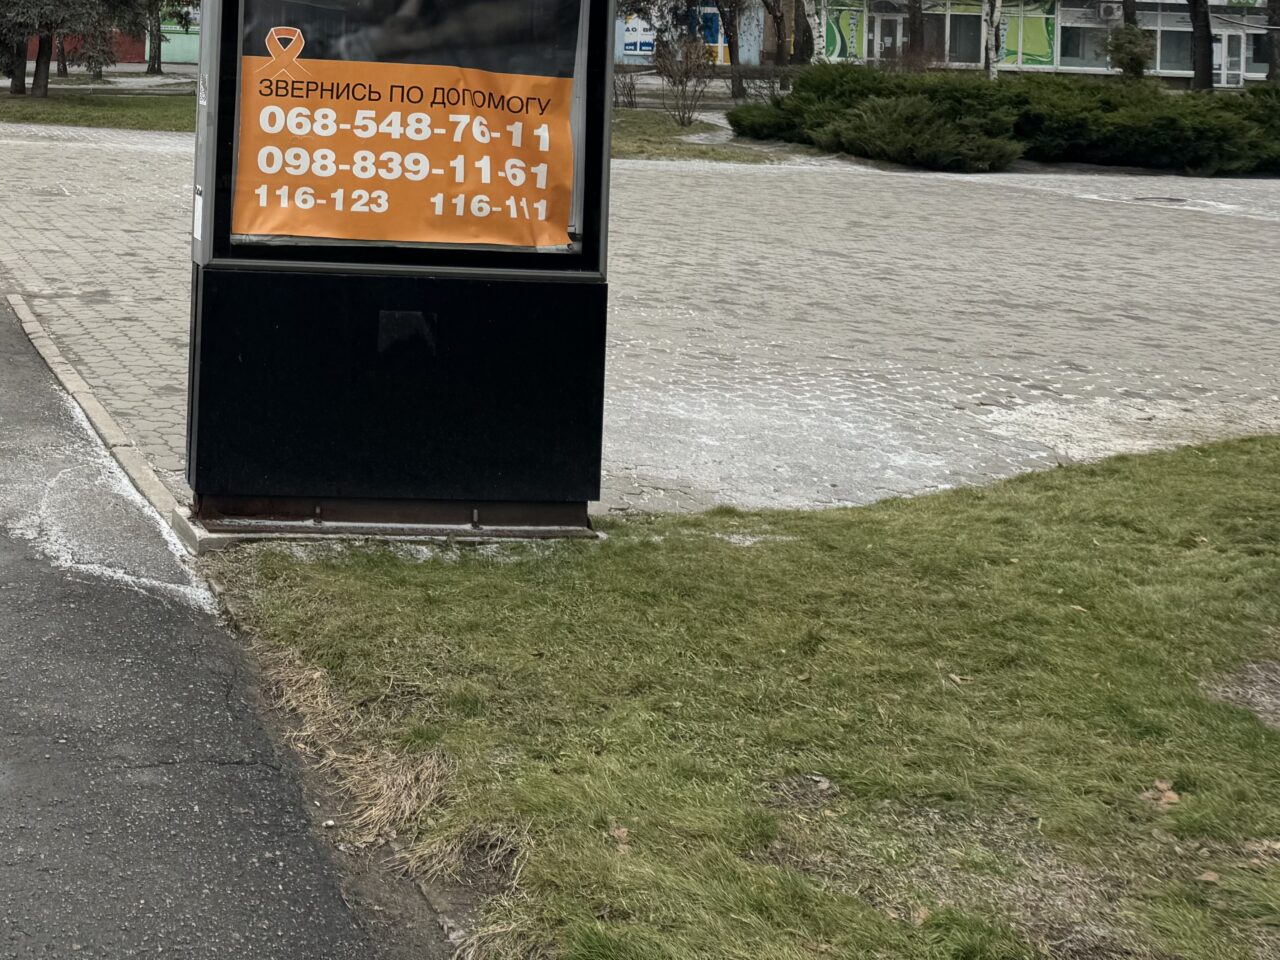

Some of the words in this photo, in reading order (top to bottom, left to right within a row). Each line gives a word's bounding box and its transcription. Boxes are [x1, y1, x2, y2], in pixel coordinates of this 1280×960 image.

[258, 78, 381, 103] ЗВЕРНИСЬ
[390, 84, 424, 104] ПО
[430, 87, 552, 116] ДОПОМОГУ
[259, 105, 550, 151] 068-548-76-11
[257, 146, 548, 189] 098-839-11-61
[254, 184, 389, 213] 116-123
